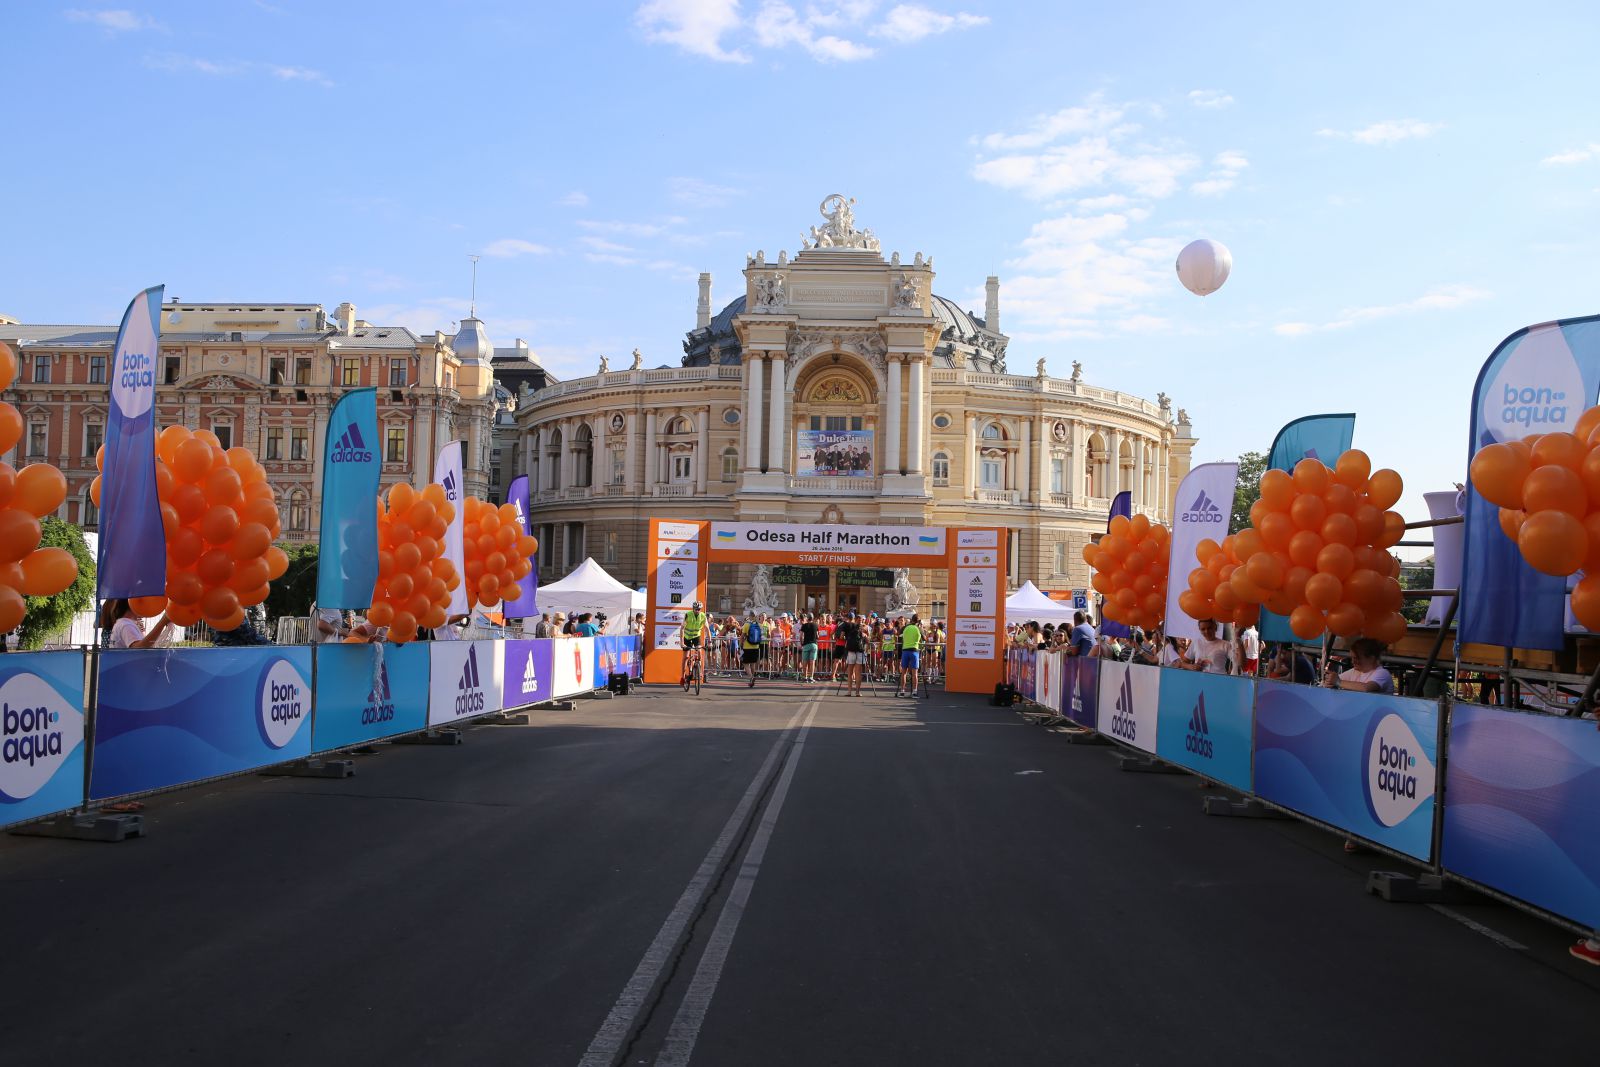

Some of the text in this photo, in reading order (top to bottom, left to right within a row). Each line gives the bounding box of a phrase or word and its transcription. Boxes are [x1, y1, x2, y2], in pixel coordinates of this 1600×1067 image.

[122, 370, 152, 392] aqua
[1502, 406, 1566, 428] aqua
[746, 530, 910, 546] Odesa Half Marathon
[271, 680, 294, 702] bon
[522, 676, 537, 694] adidas
[362, 700, 394, 725] adidas
[455, 686, 484, 715] adidas
[4, 704, 48, 735] bon
[271, 702, 300, 726] aqua
[1112, 708, 1136, 742] adidas
[3, 731, 62, 767] aqua
[1186, 732, 1213, 759] adidas
[1379, 736, 1408, 771] bon
[1378, 768, 1416, 800] aqua
